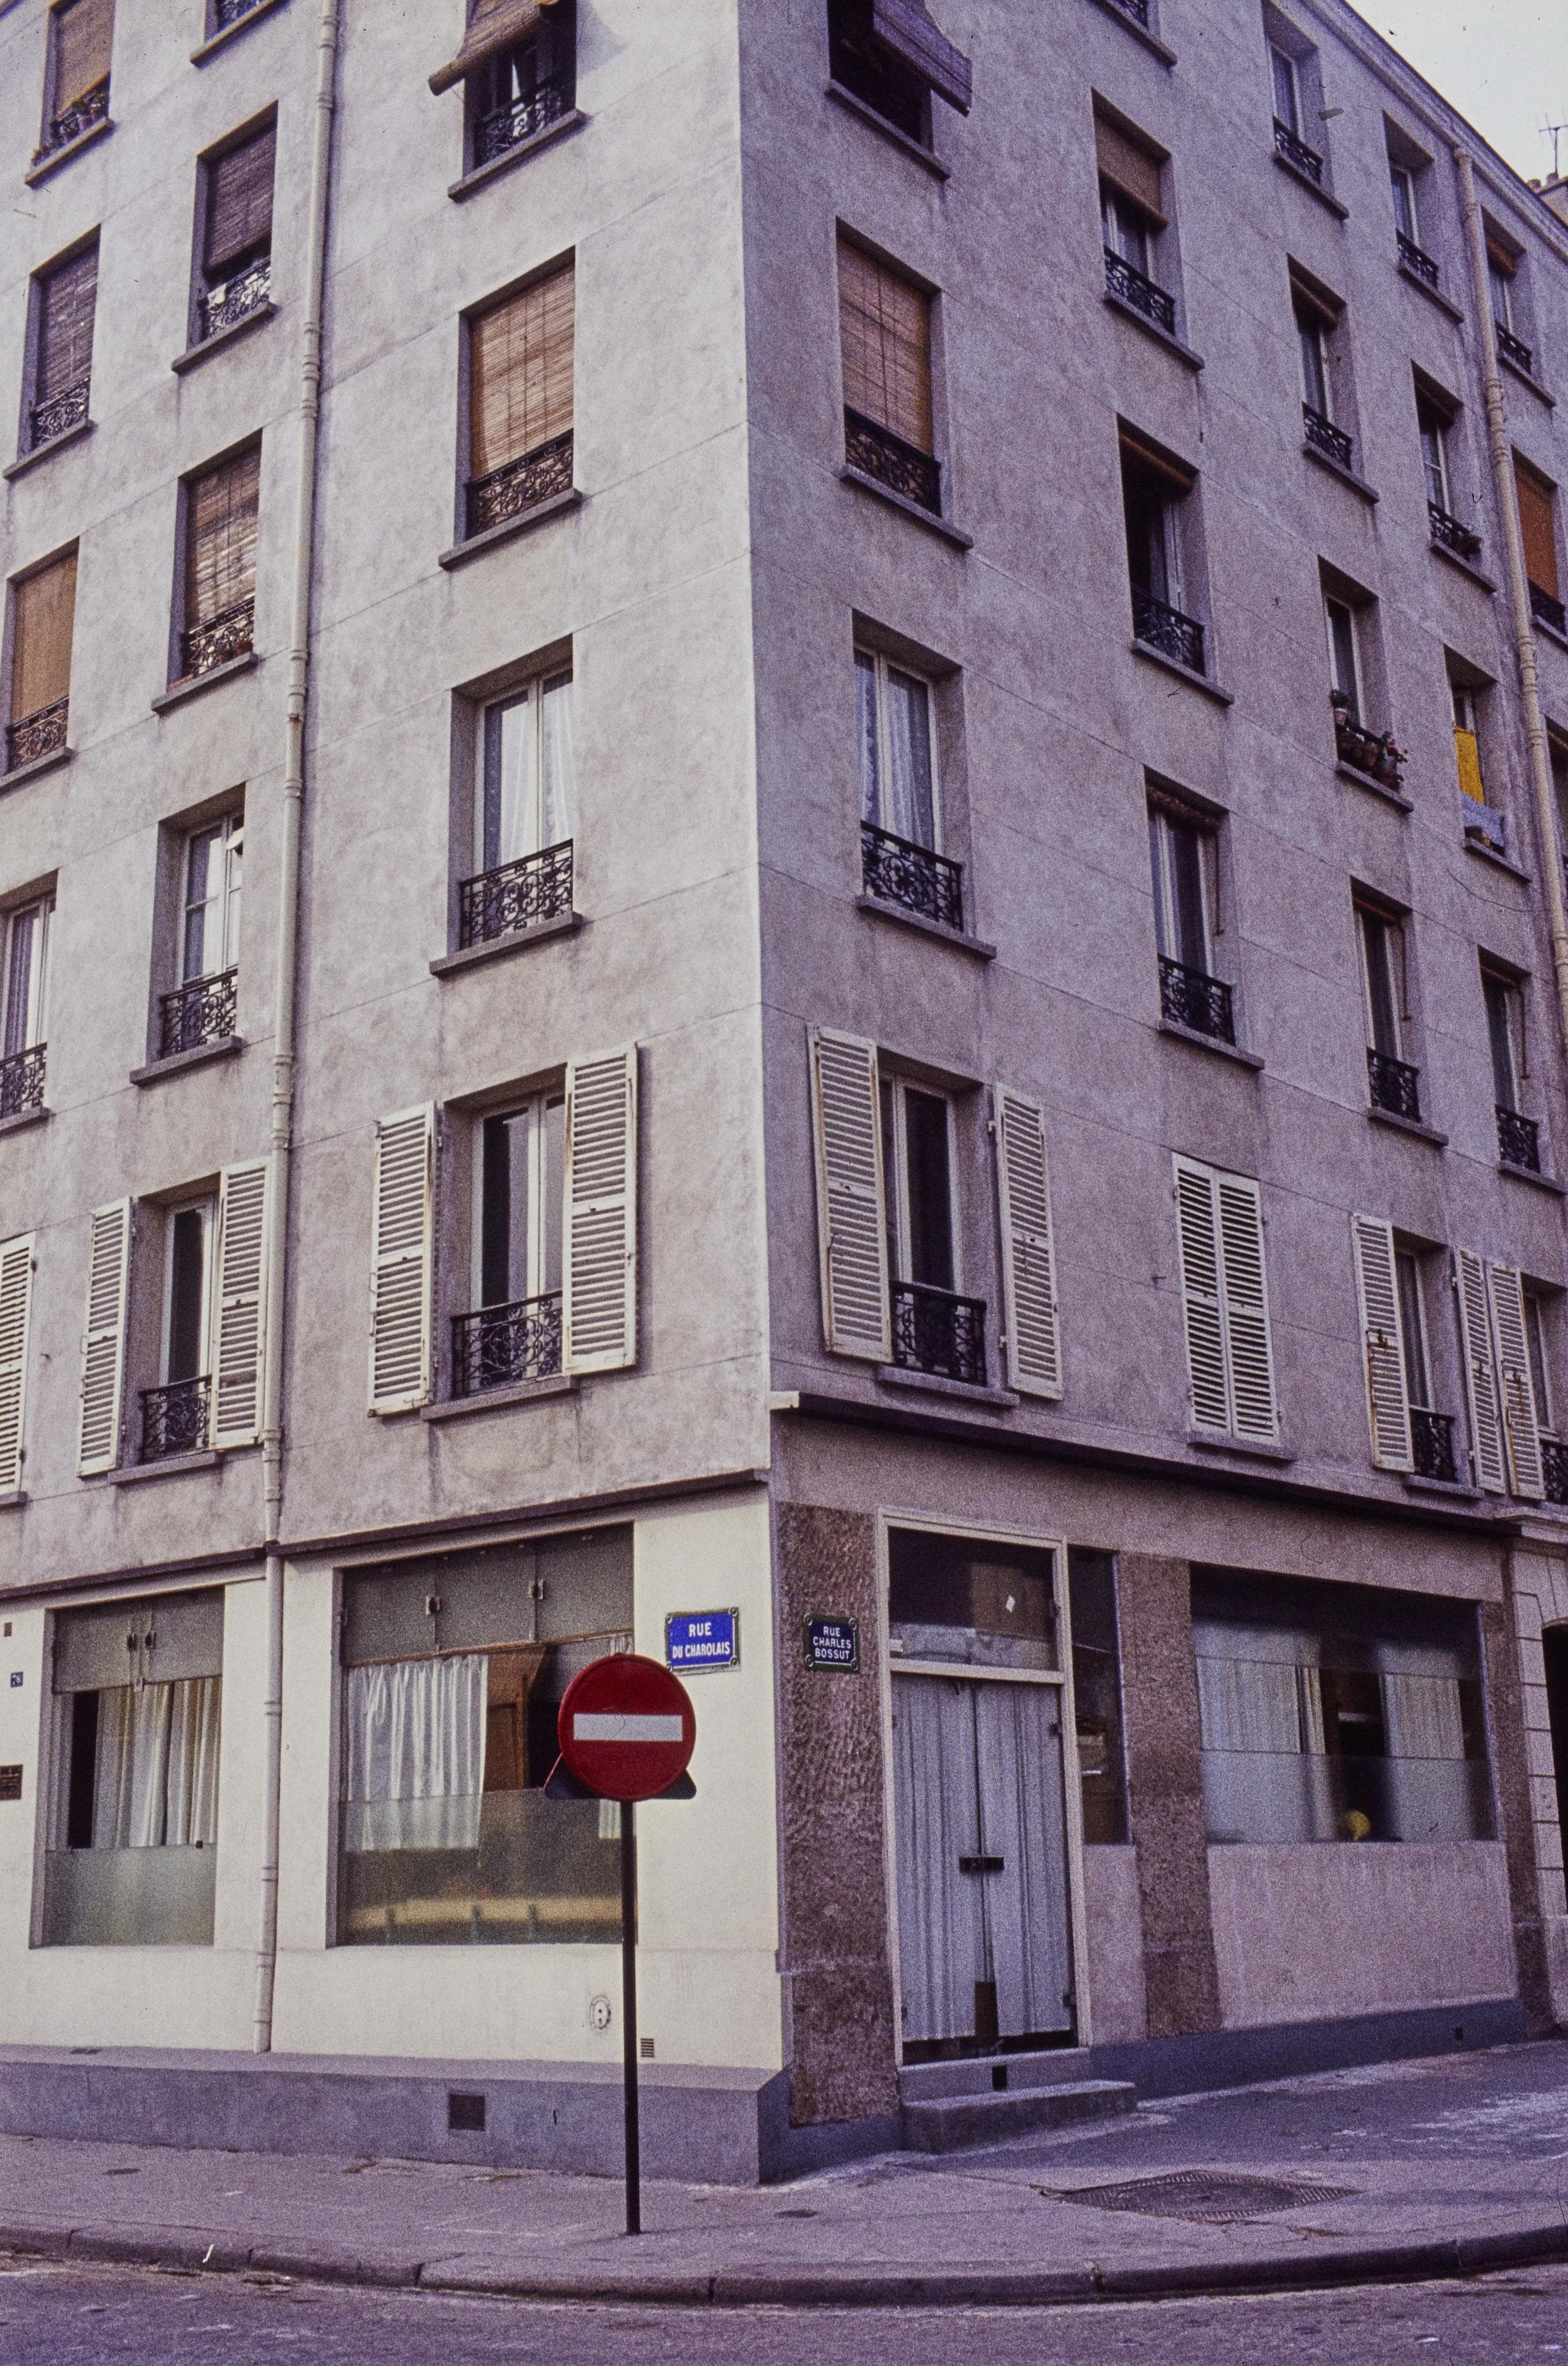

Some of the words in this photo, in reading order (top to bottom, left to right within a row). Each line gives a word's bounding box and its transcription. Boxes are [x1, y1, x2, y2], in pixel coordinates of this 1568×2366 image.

[689, 1622, 712, 1637] RUE
[823, 1626, 841, 1637] RUE
[813, 1636, 852, 1649] CHARLES
[672, 1645, 683, 1659] DU
[685, 1641, 730, 1657] CHAROLAIS
[815, 1647, 850, 1660] BOSSUT
